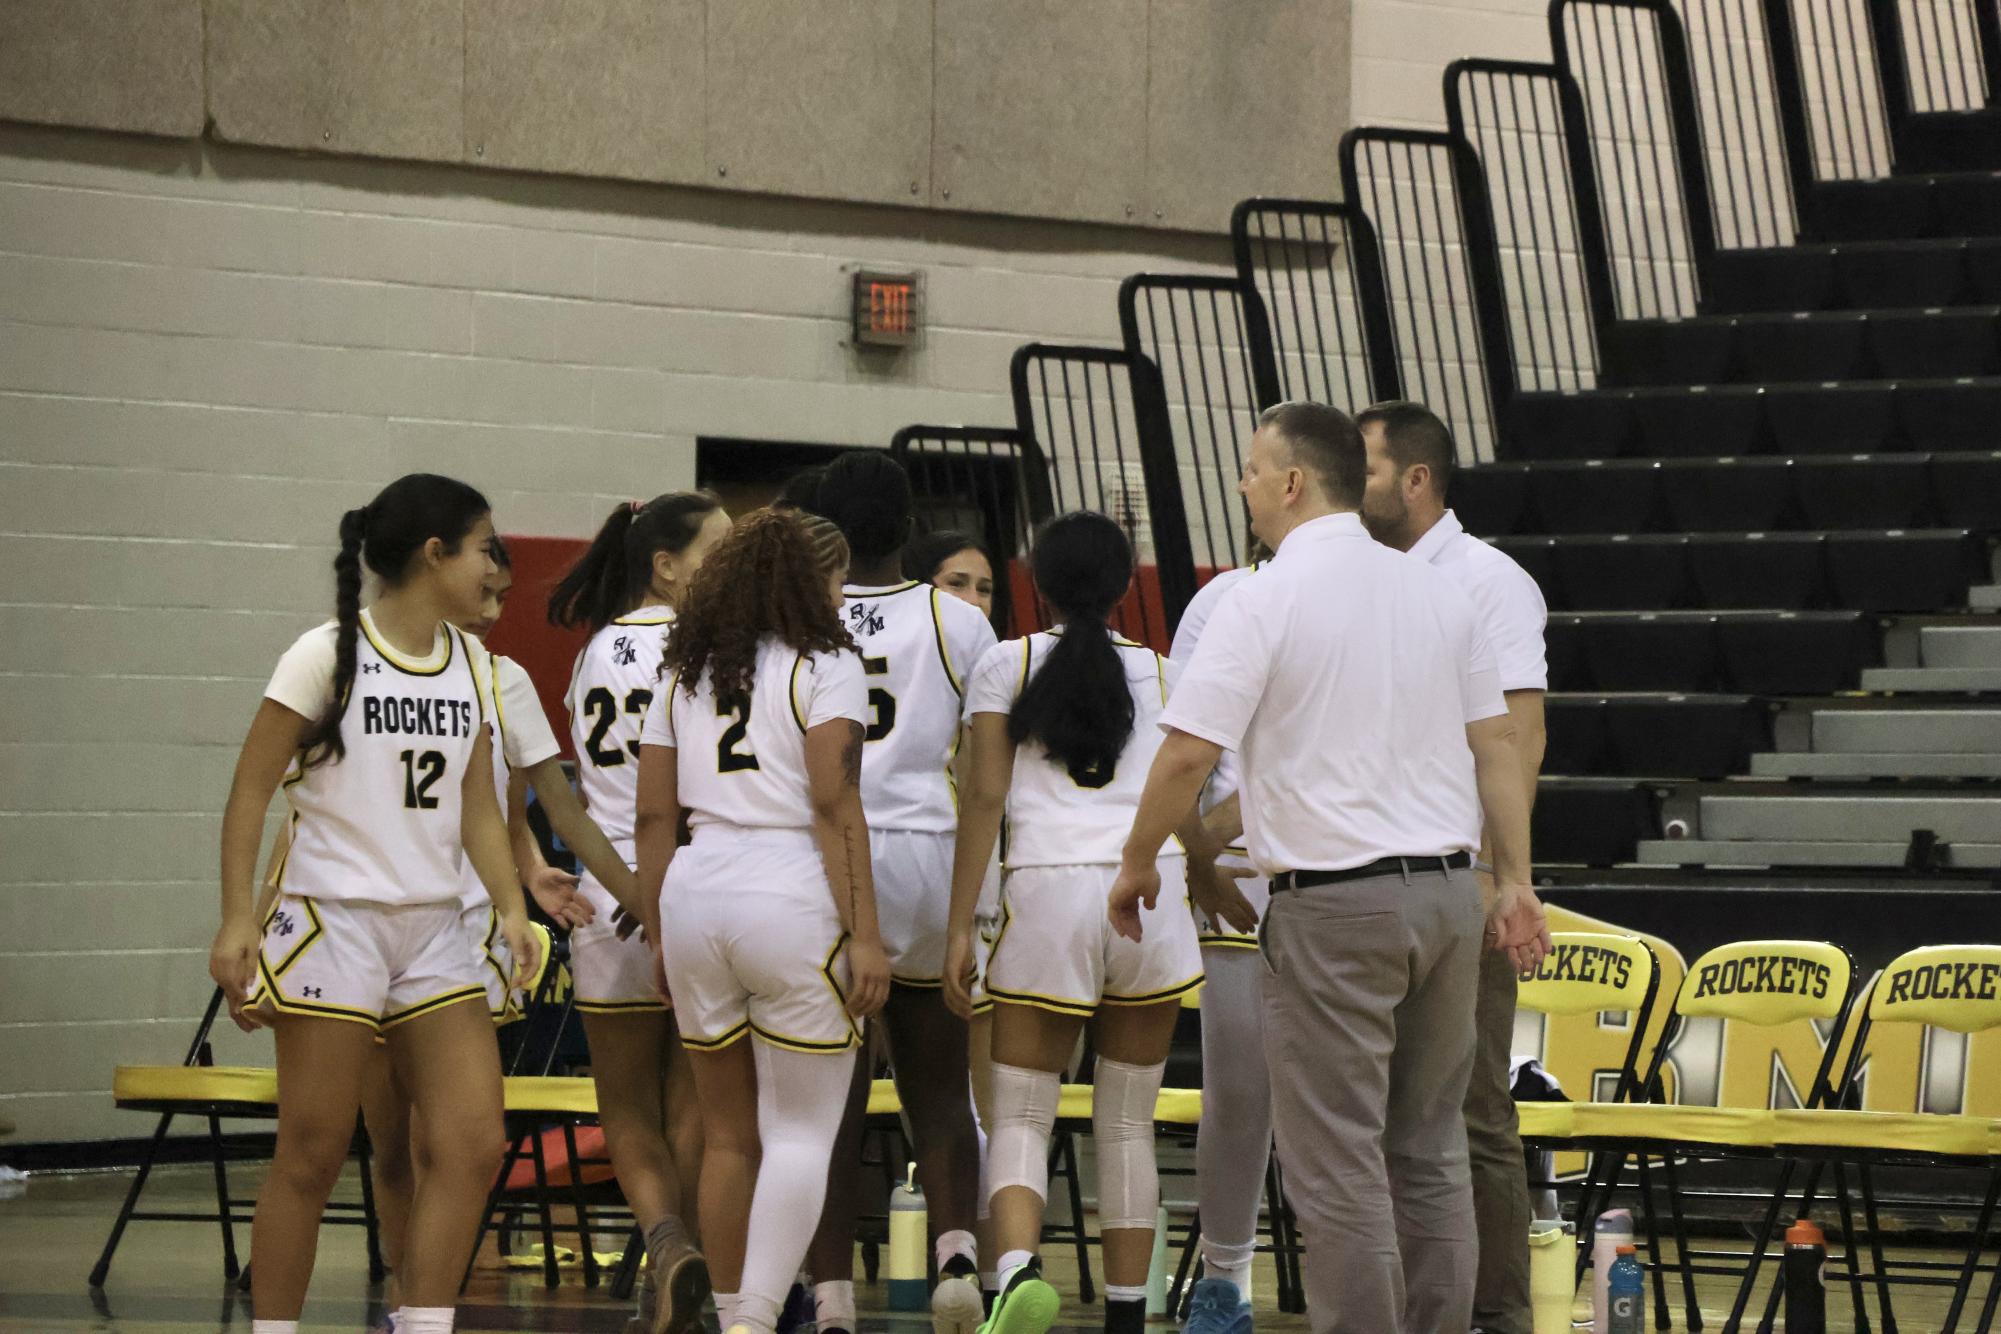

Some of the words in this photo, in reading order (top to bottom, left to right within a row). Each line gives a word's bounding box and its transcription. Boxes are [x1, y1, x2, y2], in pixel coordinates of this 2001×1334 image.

[870, 282, 910, 332] EXIT
[363, 695, 471, 739] ROCKETS
[716, 688, 761, 774] 2
[400, 749, 447, 809] 12
[1518, 944, 1633, 990] CKETS
[1694, 955, 1831, 999] ROCKETS
[1885, 963, 2001, 1005] ROCKE
[1614, 1297, 1632, 1318] G
